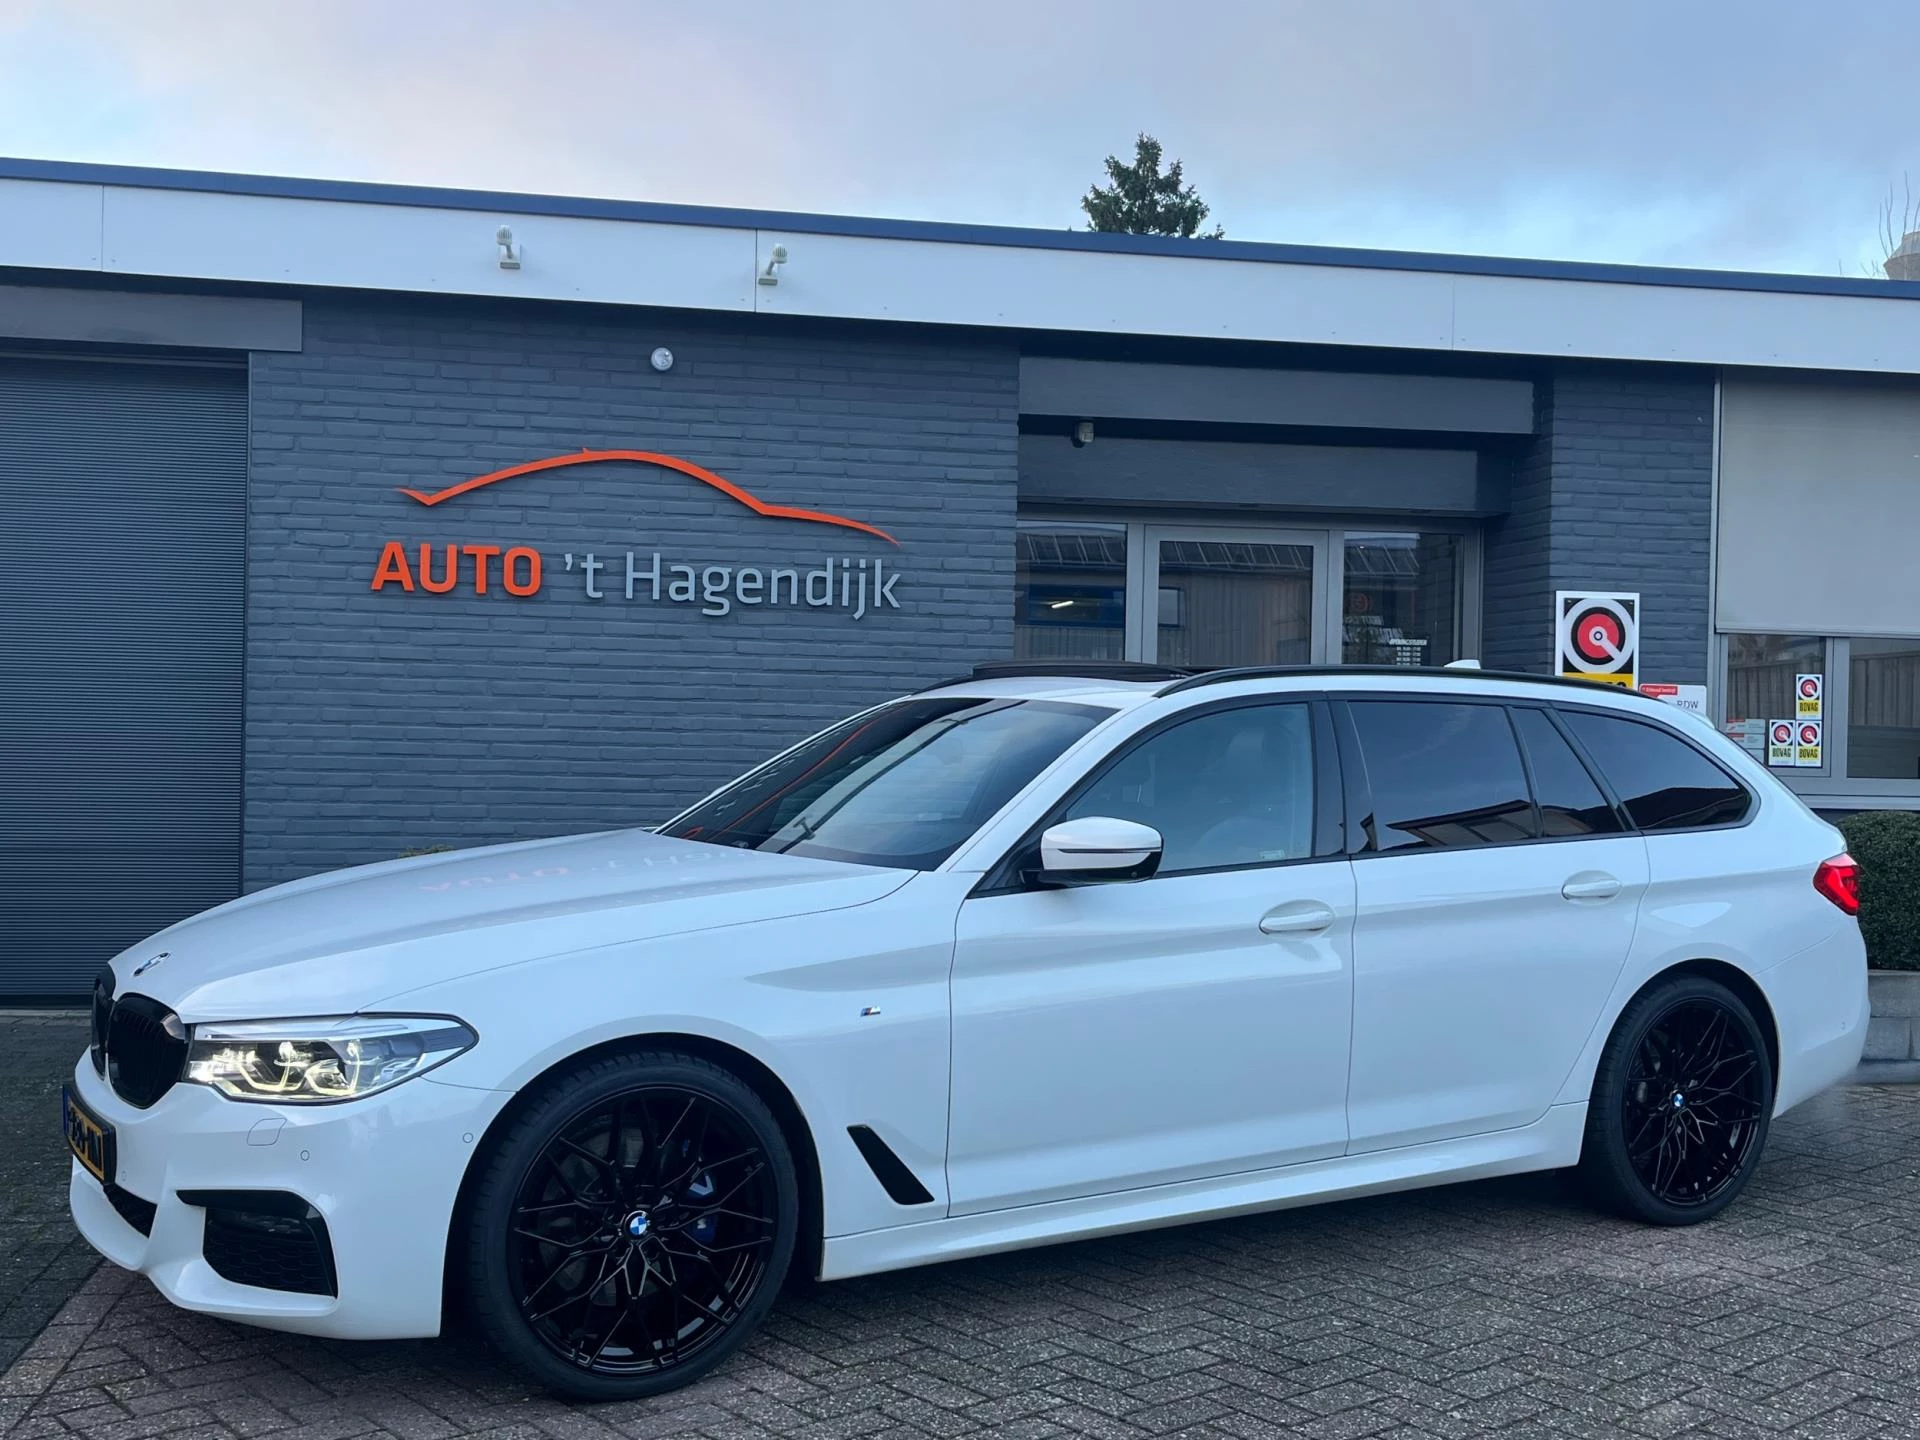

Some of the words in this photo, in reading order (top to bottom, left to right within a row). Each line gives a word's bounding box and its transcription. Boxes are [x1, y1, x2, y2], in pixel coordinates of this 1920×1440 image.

[371, 541, 541, 597] AUTO
[625, 551, 902, 621] Hagendijk
[1799, 702, 1819, 712] BOVAG
[1772, 747, 1792, 758] BOVAG
[1799, 748, 1818, 758] BOVAG
